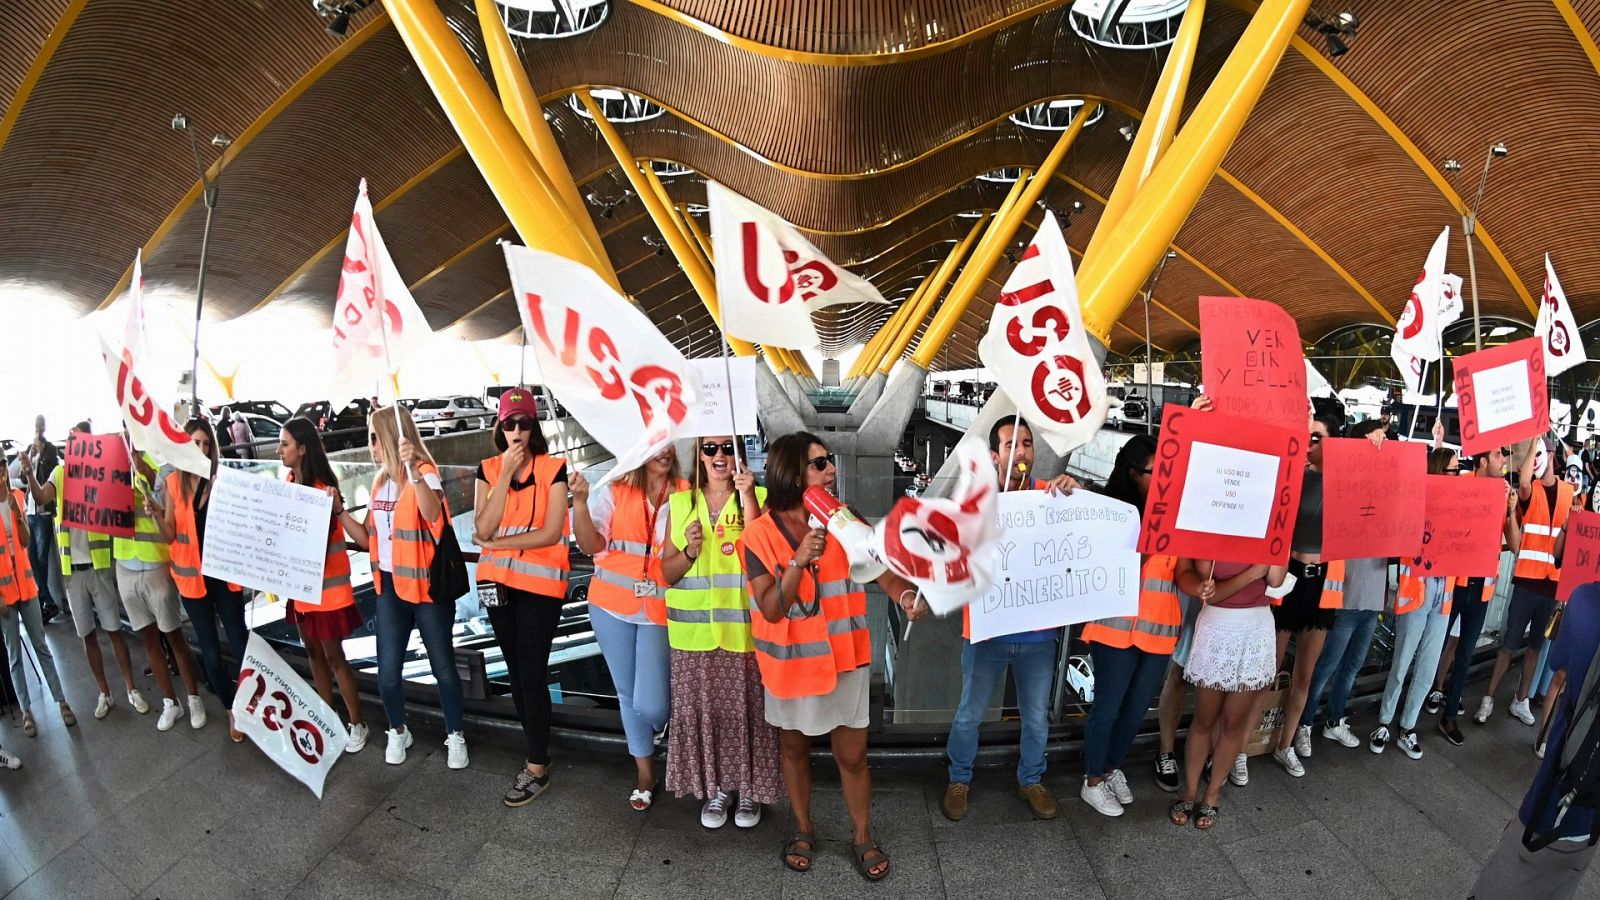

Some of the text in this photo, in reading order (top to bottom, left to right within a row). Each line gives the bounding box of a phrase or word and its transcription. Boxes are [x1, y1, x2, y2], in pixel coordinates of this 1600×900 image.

[1246, 329, 1285, 349] VER
[1216, 368, 1231, 385] Y
[1145, 412, 1184, 552] CONVENIO
[1224, 478, 1241, 486] VENDE
[84, 485, 97, 504] UN
[1270, 436, 1300, 556] DIGNO
[1211, 500, 1237, 510] DEFIENDE
[726, 514, 745, 526] US
[1576, 522, 1600, 541] NUEST
[999, 532, 1092, 571] Y MÁS
